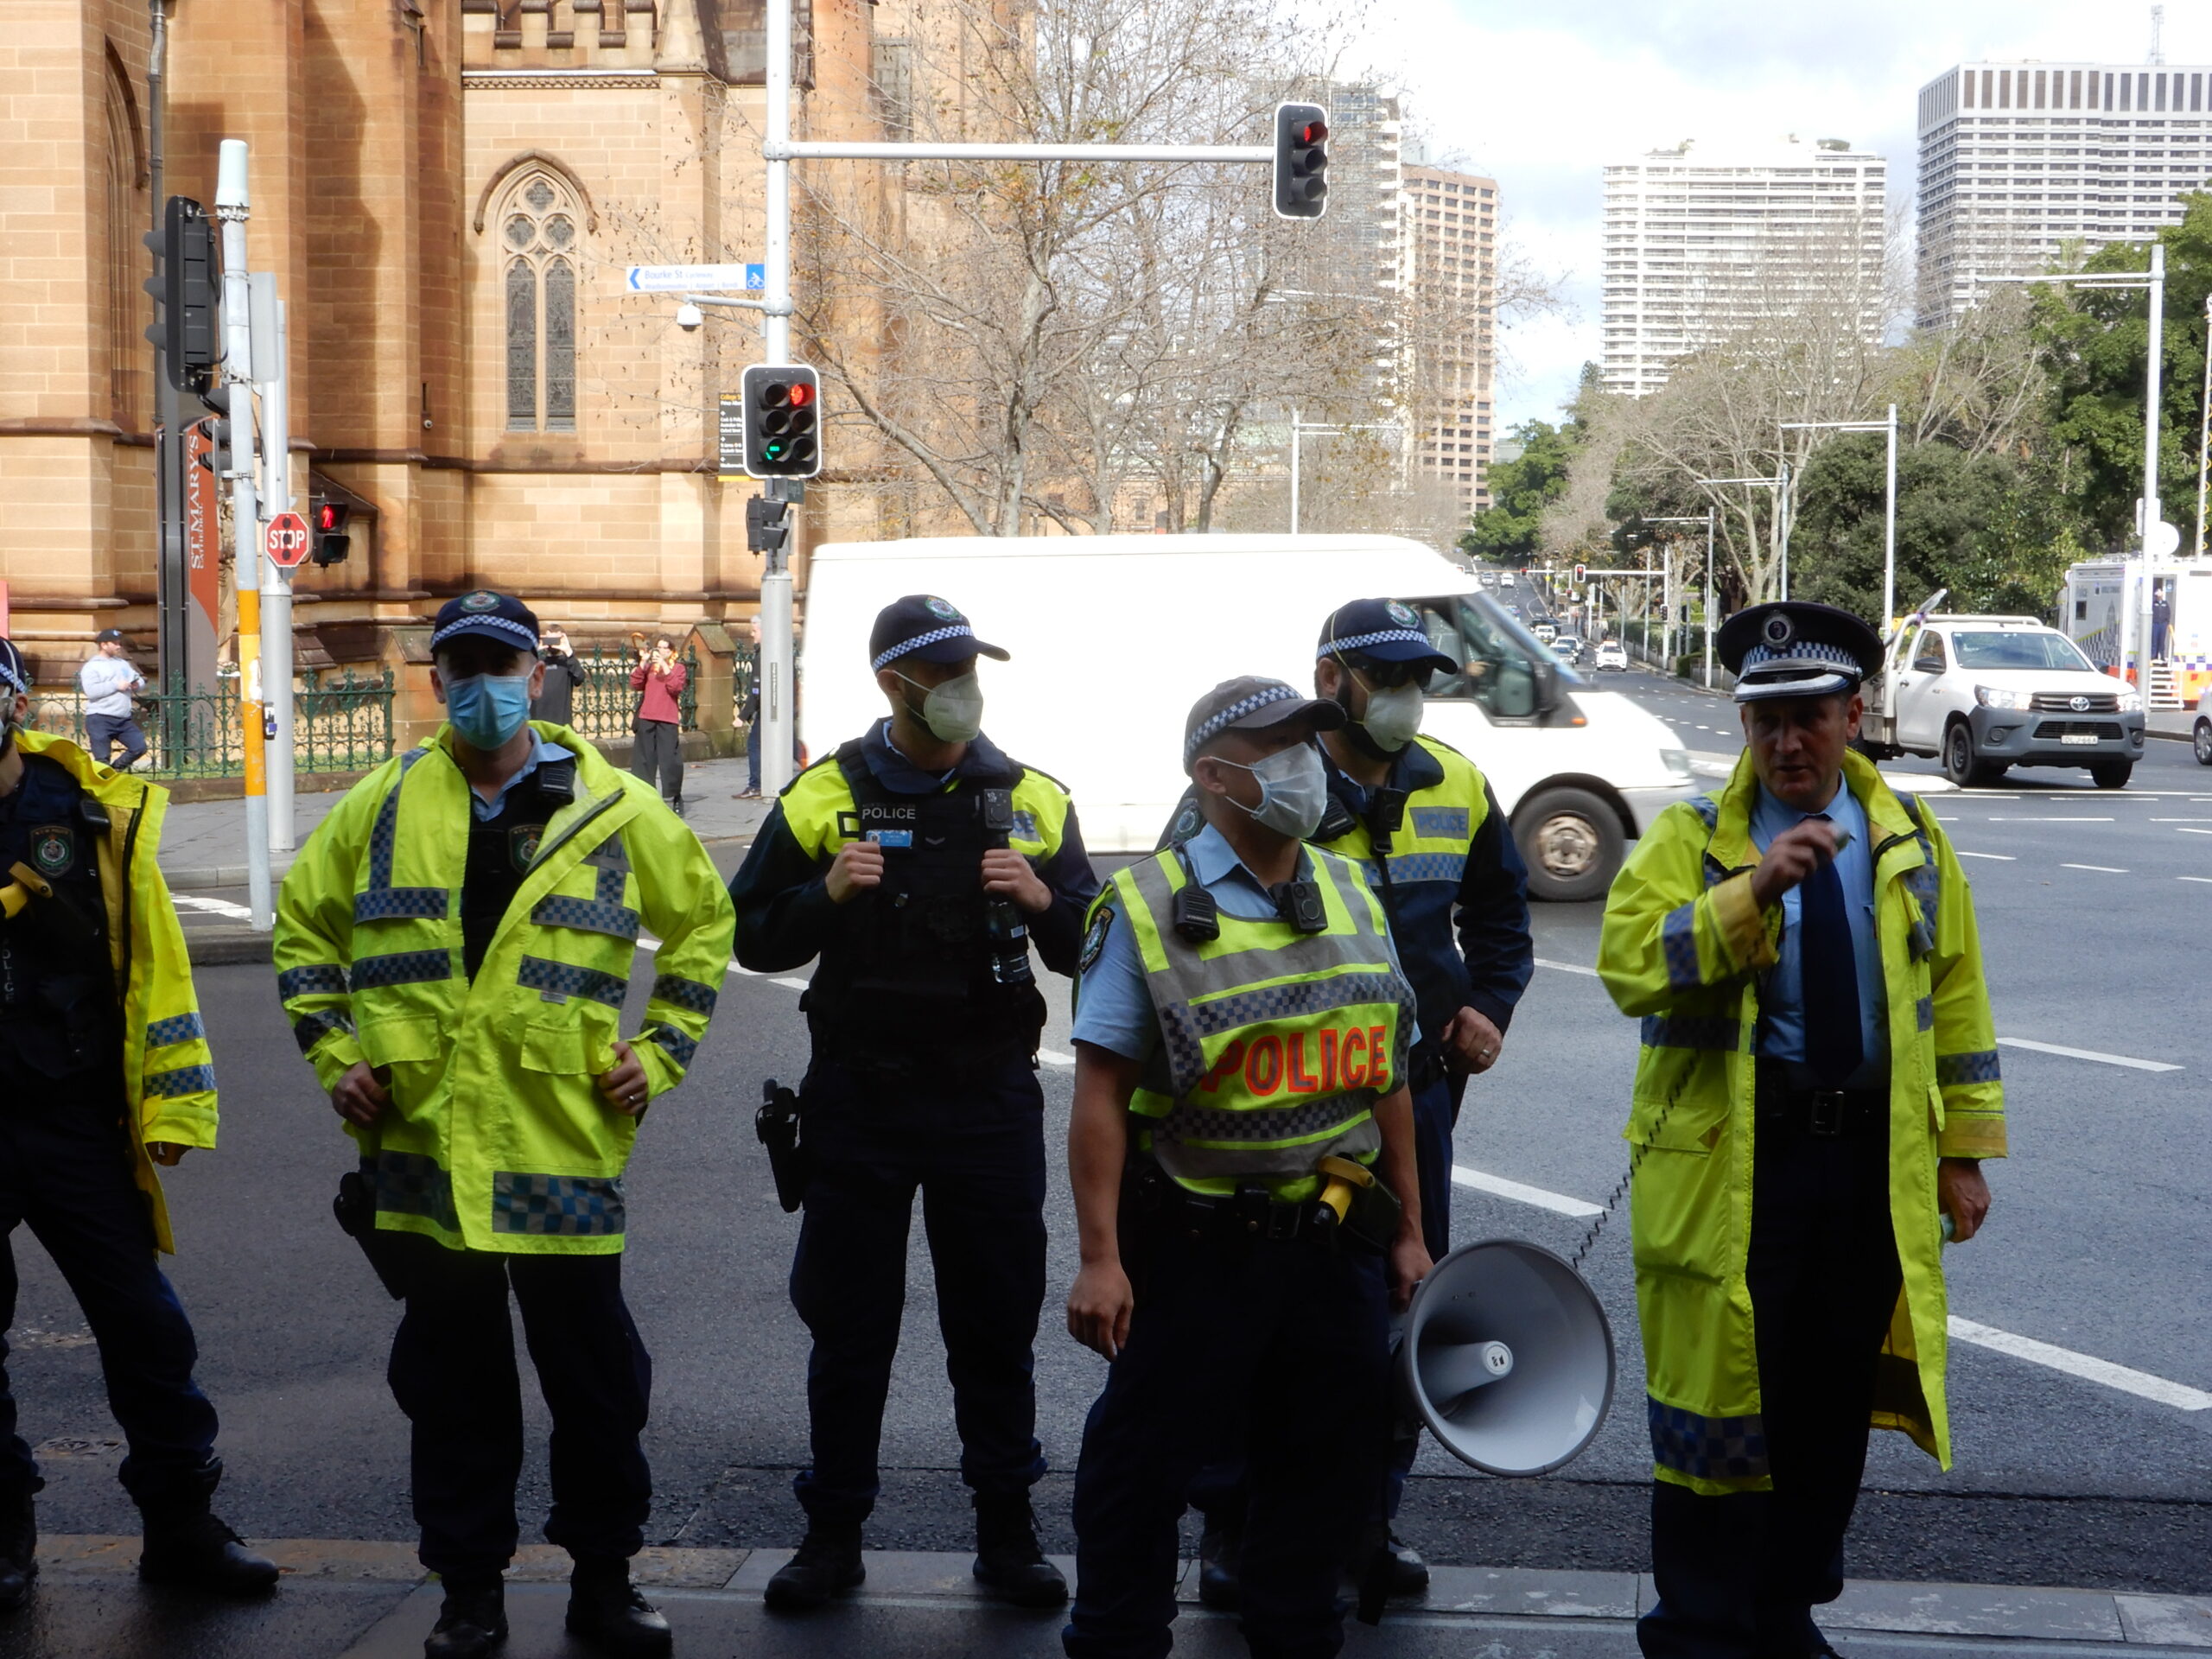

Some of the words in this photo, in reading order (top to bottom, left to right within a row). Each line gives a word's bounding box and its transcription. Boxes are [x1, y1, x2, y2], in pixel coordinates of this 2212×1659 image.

[645, 270, 672, 279] Bourke
[675, 270, 683, 278] St
[189, 435, 200, 532] MARY'S
[269, 530, 306, 550] STOP
[861, 807, 916, 820] POLICE
[1417, 814, 1466, 831] POLICE
[1199, 1025, 1389, 1096] POLICE
